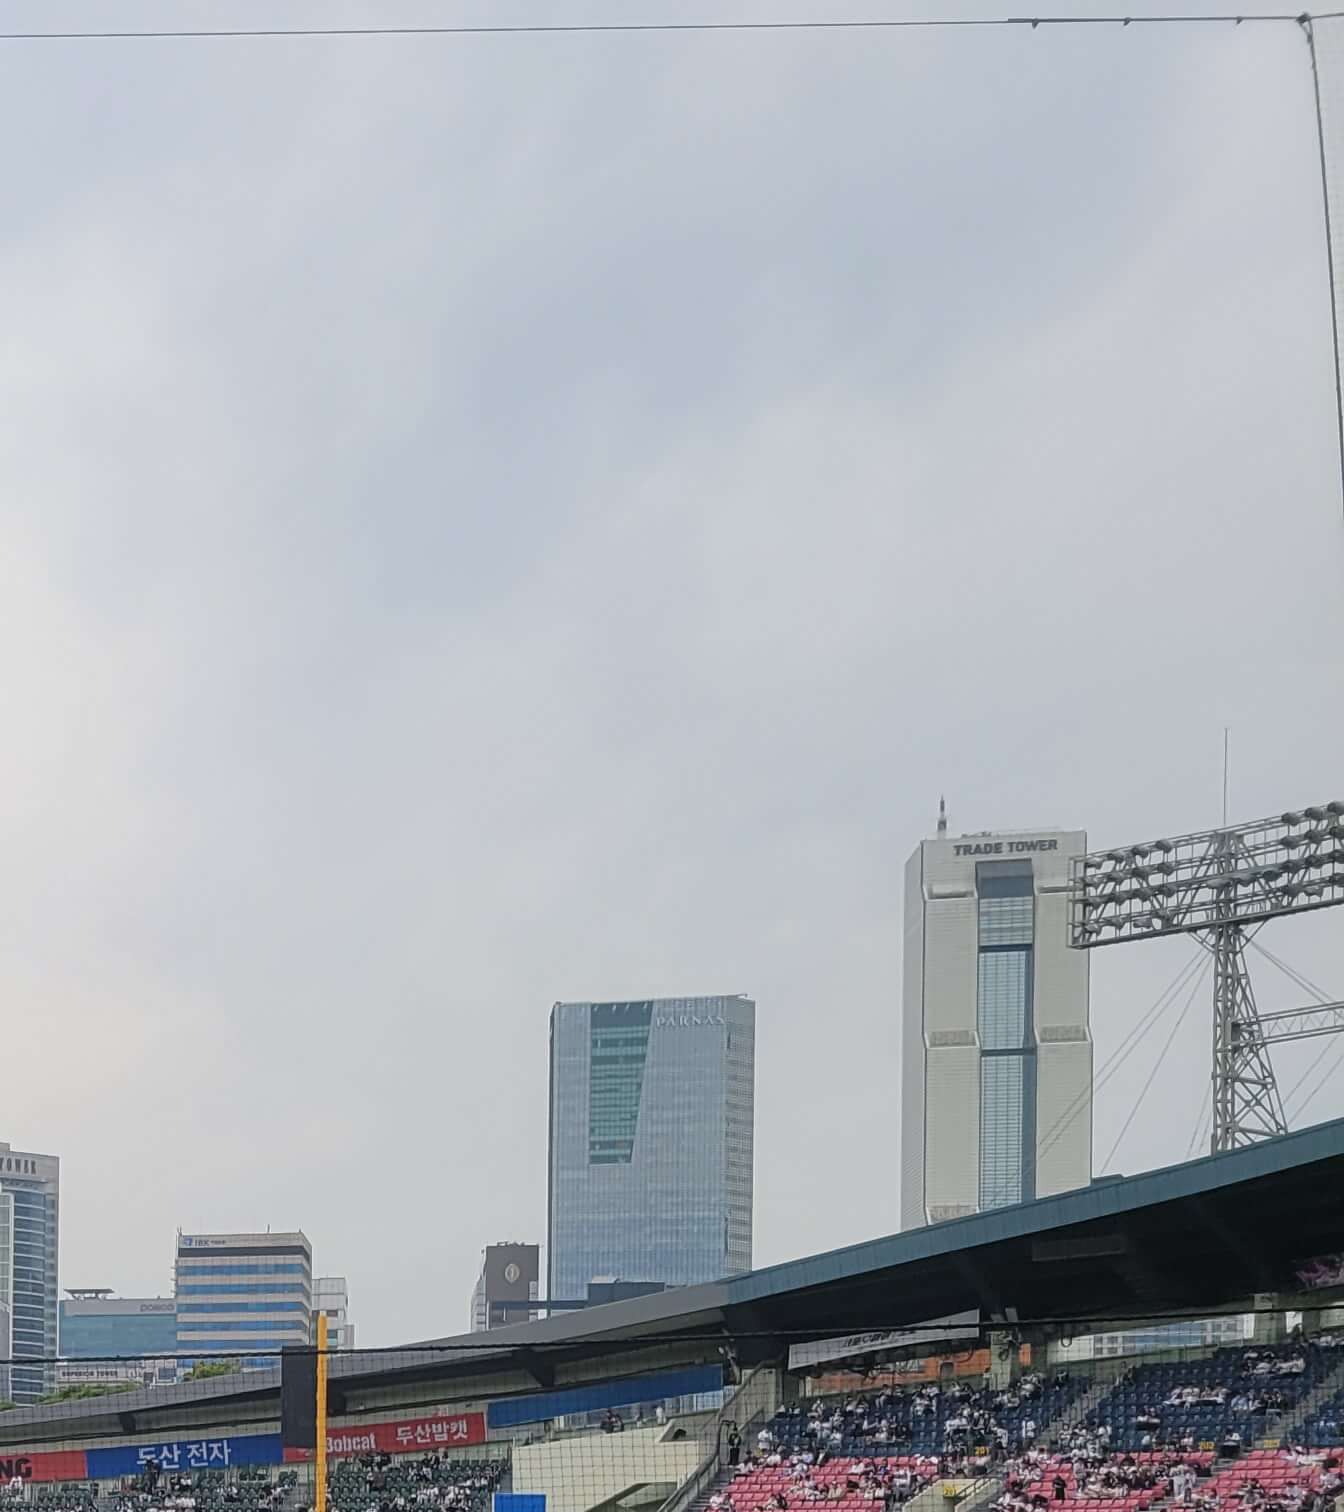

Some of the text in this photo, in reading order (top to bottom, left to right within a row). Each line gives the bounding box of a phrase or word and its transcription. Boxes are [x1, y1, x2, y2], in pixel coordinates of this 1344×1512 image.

[952, 839, 1058, 856] TRADE TOWER
[395, 1420, 469, 1446] 두산밥캣
[185, 1439, 233, 1468] 전자
